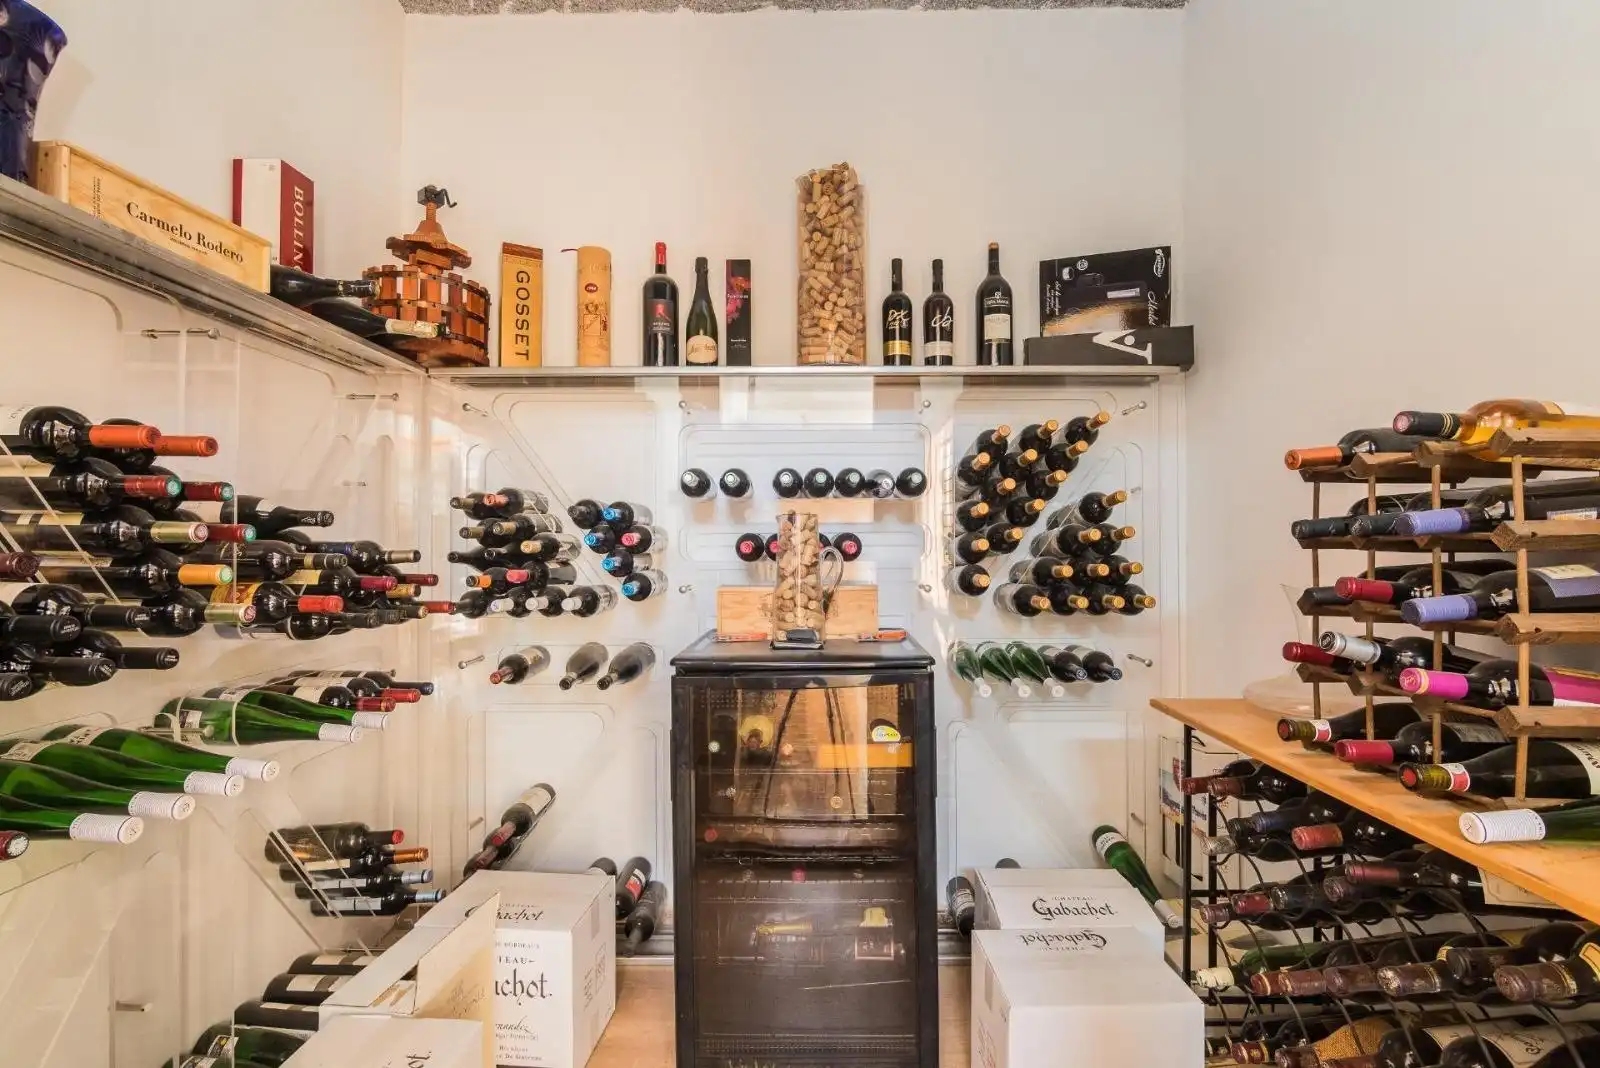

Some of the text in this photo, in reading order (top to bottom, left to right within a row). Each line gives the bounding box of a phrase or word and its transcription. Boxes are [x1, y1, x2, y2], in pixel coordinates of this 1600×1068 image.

[126, 201, 192, 241] Carmelo
[196, 231, 244, 264] Rodero
[515, 270, 530, 361] GOSSET
